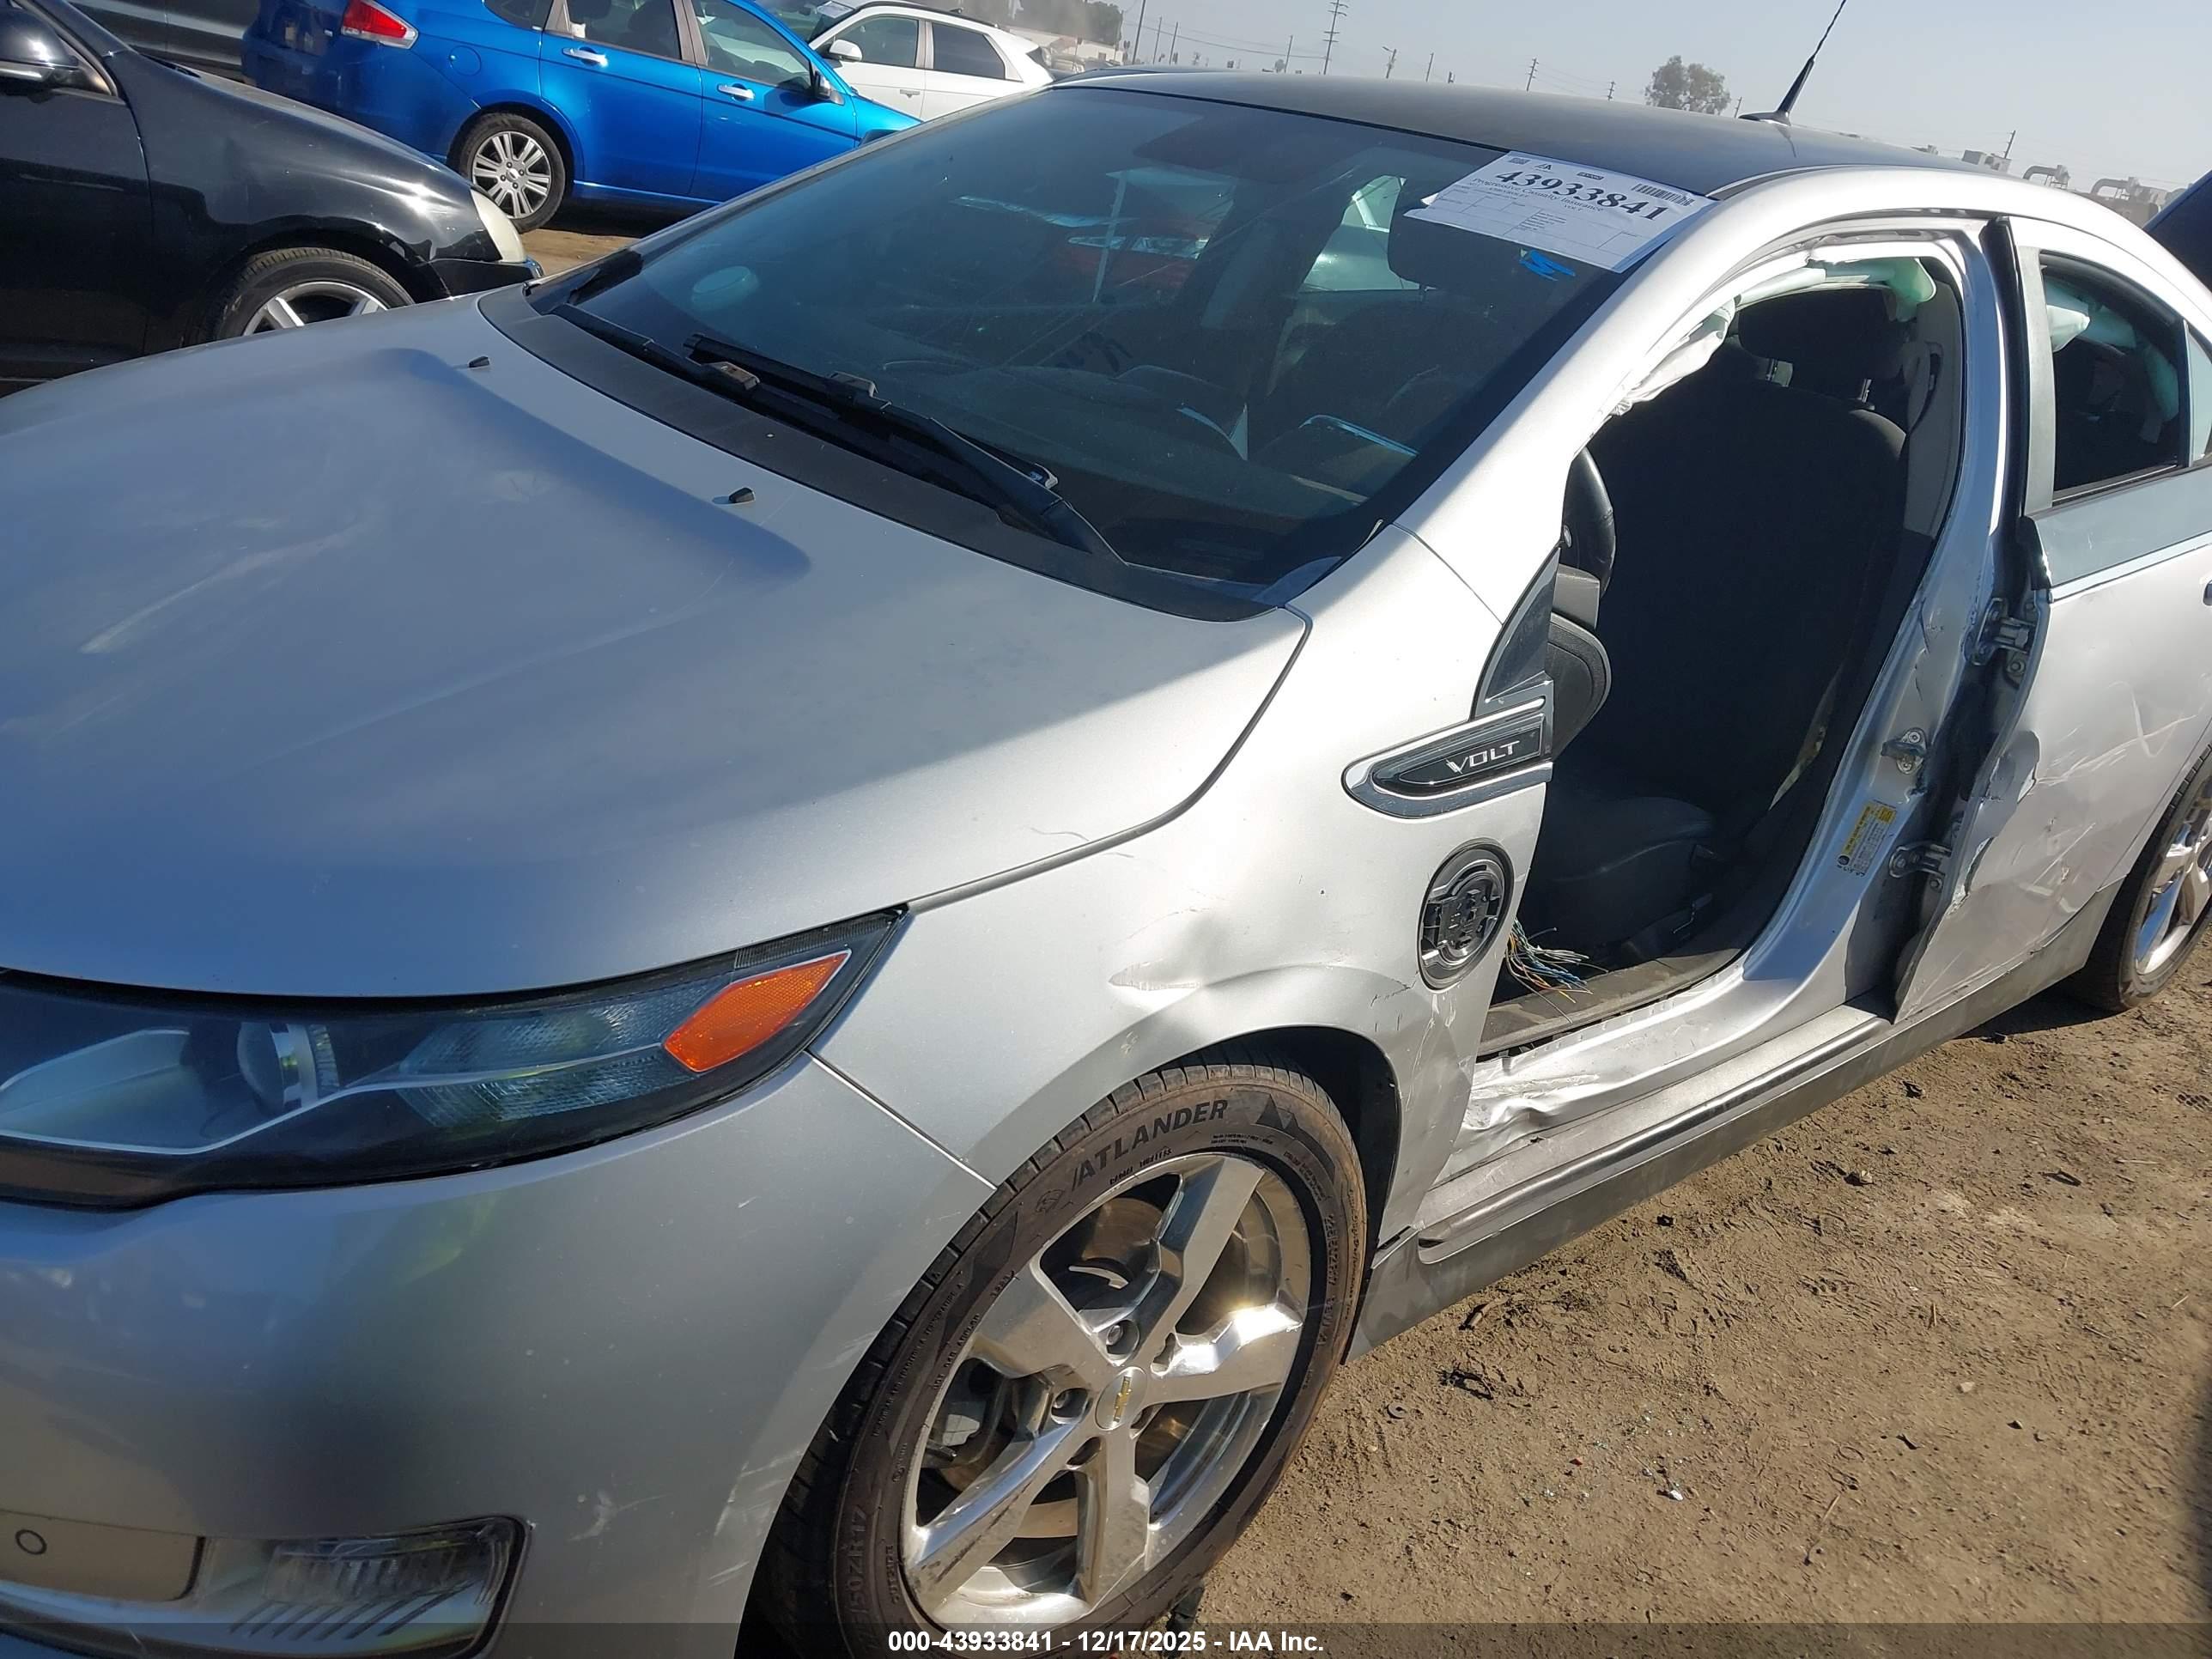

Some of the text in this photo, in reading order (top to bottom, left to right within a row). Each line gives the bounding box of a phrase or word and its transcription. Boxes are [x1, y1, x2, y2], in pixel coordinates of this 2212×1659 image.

[1472, 178, 1521, 191] Progressive
[1522, 188, 1559, 201] Casualty
[1561, 197, 1605, 212] Insurance
[1495, 171, 1668, 221] 43933841
[1446, 740, 1520, 775] VOLT
[1073, 1099, 1229, 1191] ATLANDER
